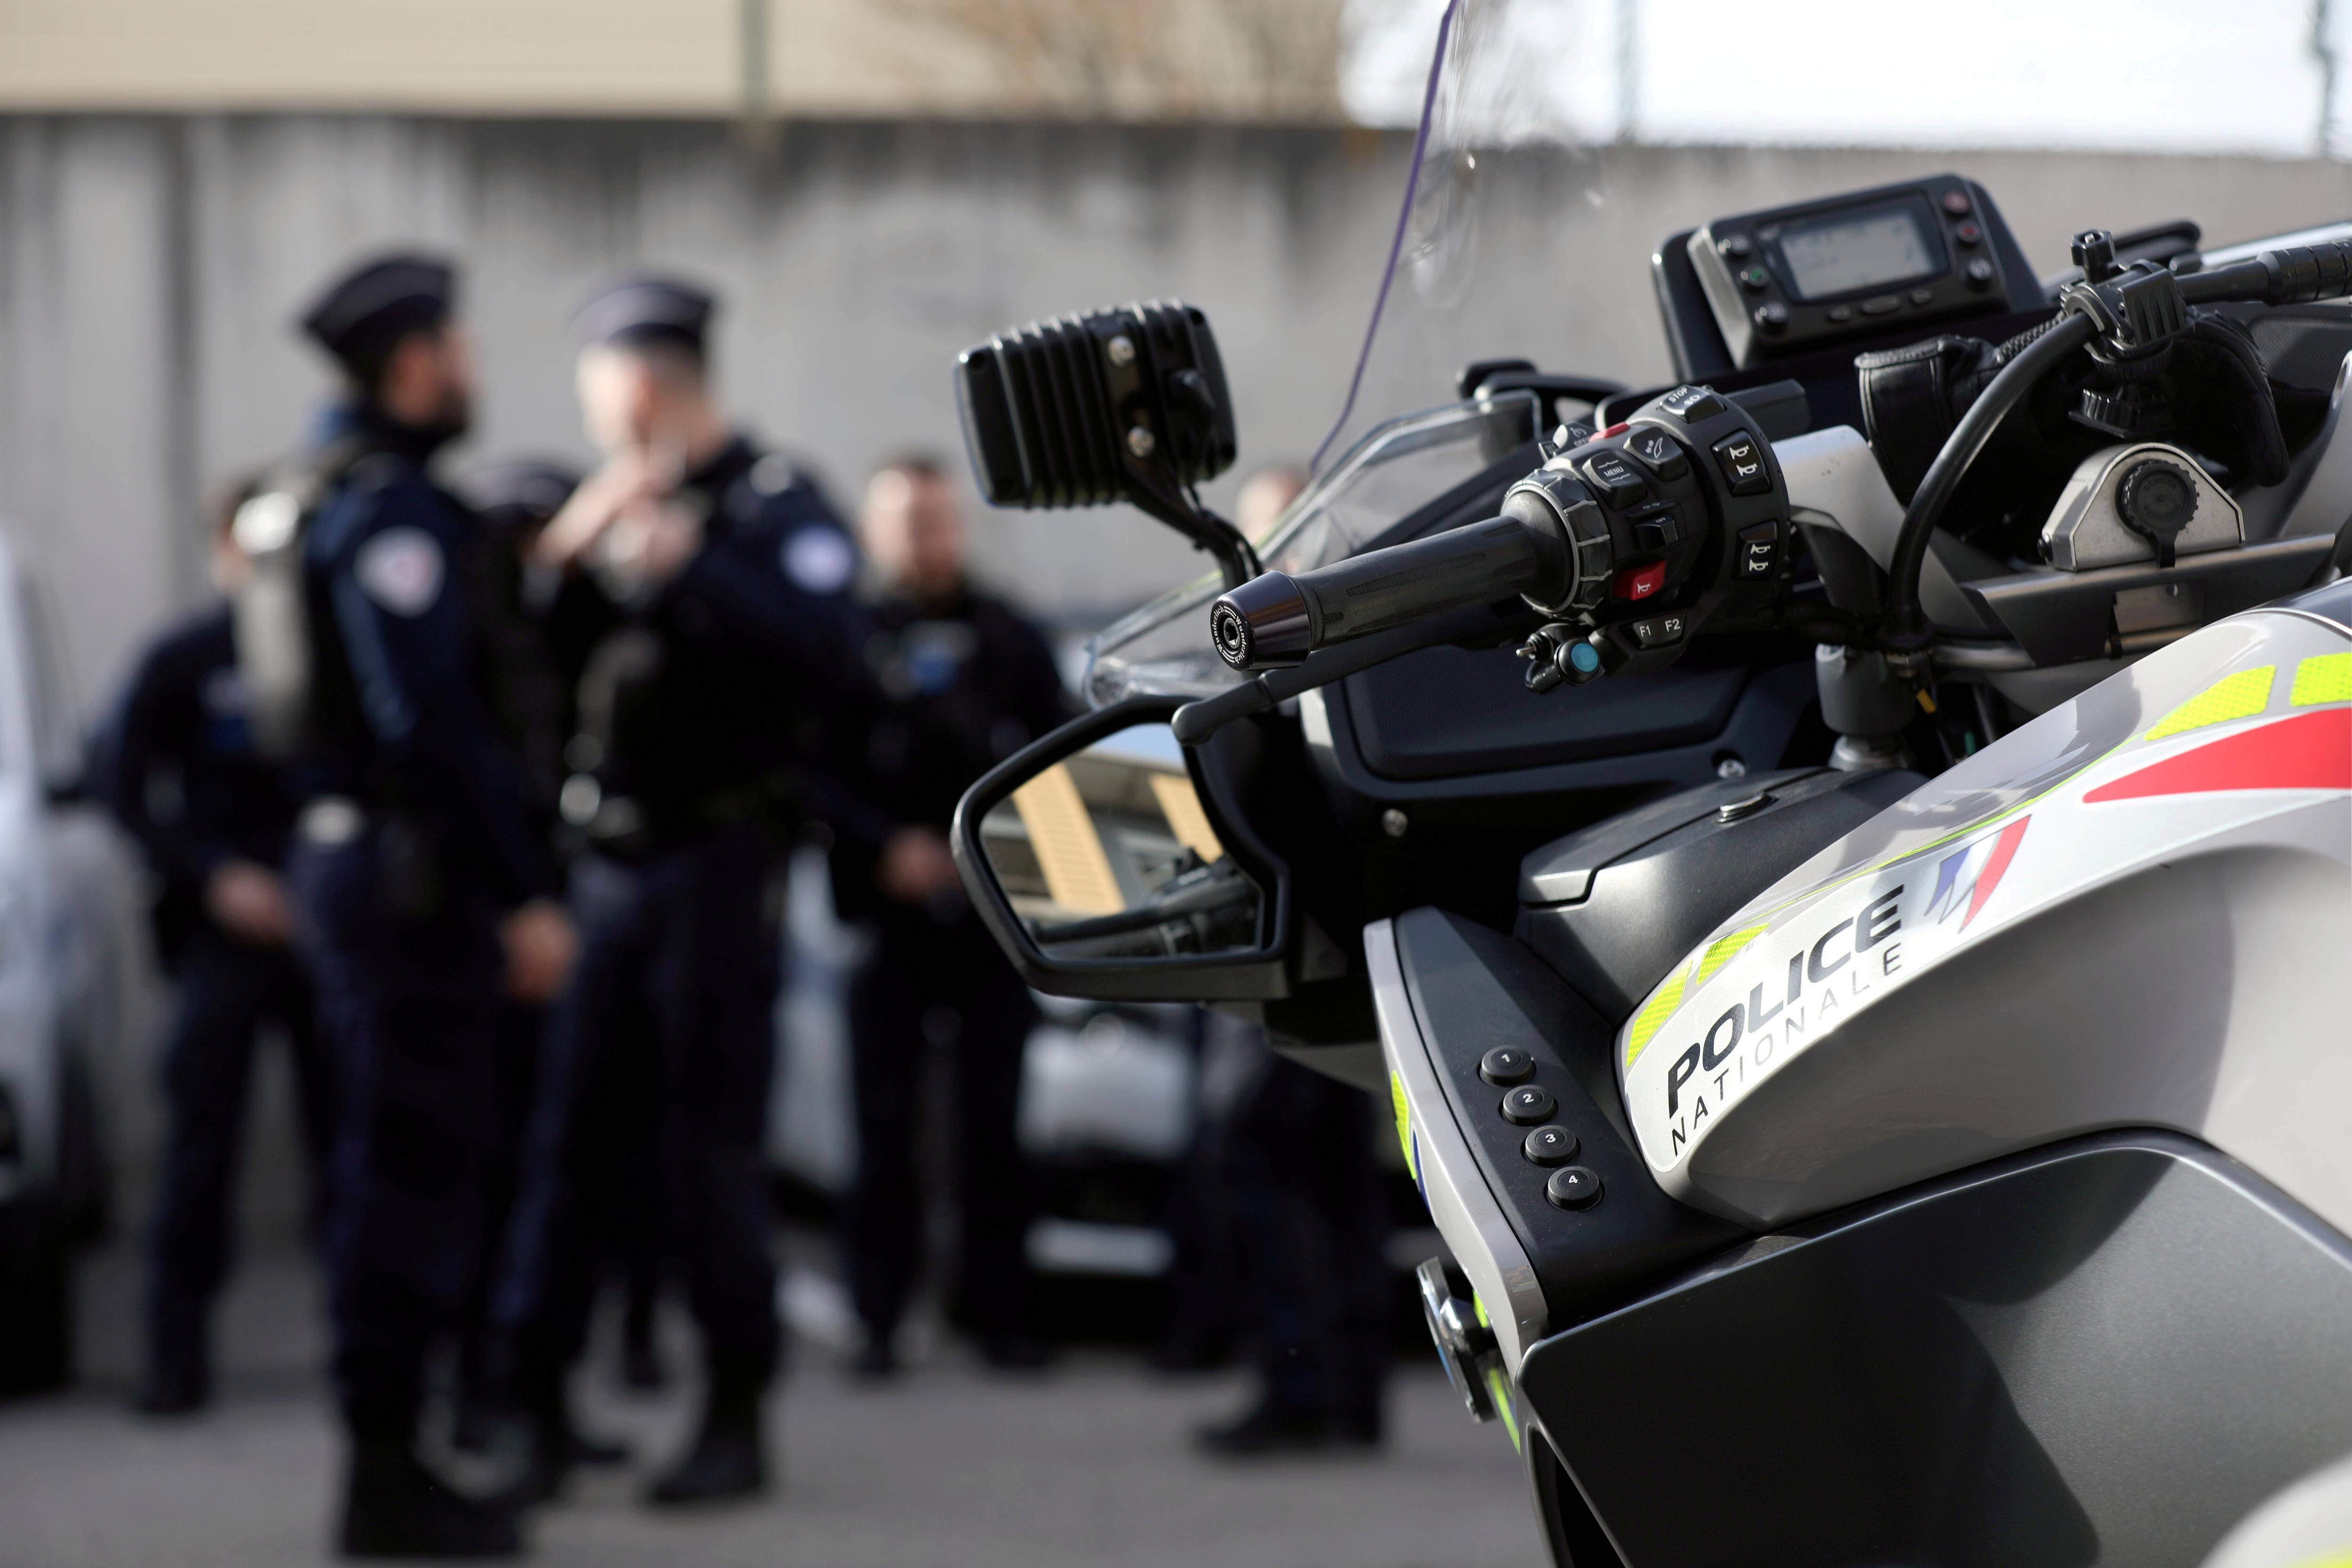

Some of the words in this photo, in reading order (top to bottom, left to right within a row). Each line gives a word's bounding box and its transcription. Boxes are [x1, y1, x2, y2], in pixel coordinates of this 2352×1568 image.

[1668, 387, 1688, 403] STOP
[1603, 466, 1624, 478] MENU
[1212, 605, 1224, 653] Wunderlich
[1640, 625, 1651, 637] F1
[1665, 619, 1681, 632] F2
[1234, 616, 1247, 664] Wunderlich
[1668, 884, 1904, 1120] POLICE
[1672, 943, 1901, 1156] NATIONALE
[1501, 1054, 1510, 1063] 1
[1522, 1093, 1534, 1103] 2
[1545, 1133, 1556, 1143] 3
[1568, 1175, 1579, 1185] 4
